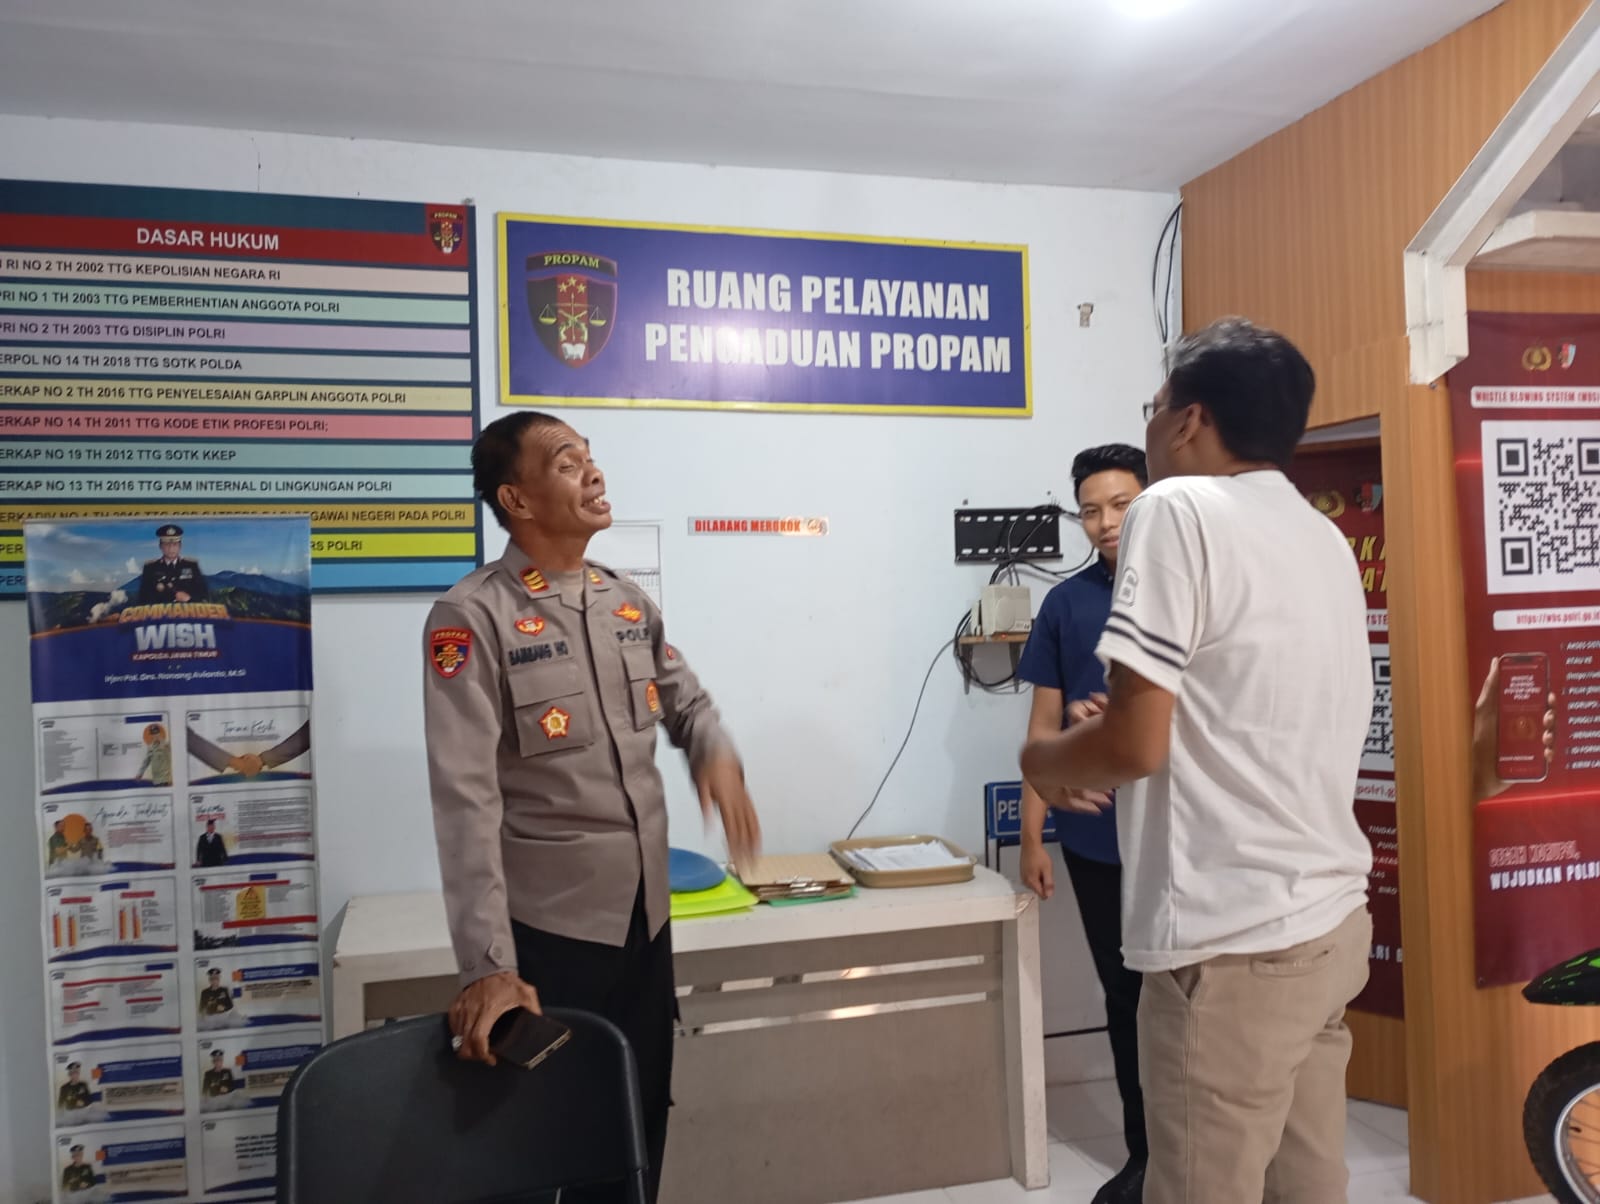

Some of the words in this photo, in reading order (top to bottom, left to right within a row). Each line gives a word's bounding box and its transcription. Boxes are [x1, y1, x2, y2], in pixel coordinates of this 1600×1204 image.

[137, 228, 204, 247] DASAR
[210, 232, 279, 250] HUKUM
[7, 259, 19, 270] RI
[23, 260, 42, 271] NO
[45, 260, 52, 271] 2
[56, 261, 72, 272] TH
[76, 261, 104, 273] 2002
[107, 262, 132, 274] TTG
[136, 264, 210, 279] KEPOLISIAN
[214, 267, 266, 281] NEGARA
[269, 270, 281, 281] RI
[544, 254, 600, 268] PROPAM
[0, 290, 15, 302] RI
[19, 291, 38, 302] NO
[42, 291, 48, 303] 1
[52, 292, 69, 303] TH
[73, 293, 101, 305] 2003
[104, 294, 129, 306] TTG
[132, 295, 239, 309] PEMBERHENTIAN
[241, 299, 301, 312] ANGGOTA
[304, 302, 340, 313] POLRI
[666, 268, 792, 313] RUANG
[801, 275, 990, 321] PELAYANAN
[0, 322, 16, 333] RI
[20, 323, 38, 334] NO
[42, 323, 49, 334] 2
[52, 323, 69, 335] TH
[73, 324, 101, 336] 2003
[104, 325, 129, 336] TTG
[133, 326, 185, 338] DISIPLIN
[188, 328, 226, 340] POLRI
[645, 323, 861, 369] PENGADUAN
[870, 332, 1012, 373] PROPAM
[43, 354, 62, 366] NO
[66, 355, 80, 366] 14
[82, 356, 100, 367] TH
[103, 356, 131, 368] 2018
[135, 357, 159, 369] TTG
[163, 357, 197, 369] SOTK
[200, 359, 243, 370] POLDA
[44, 385, 62, 397] NO
[66, 386, 74, 397] 2
[78, 386, 94, 398] TH
[97, 386, 125, 398] 2016
[129, 387, 153, 399] TTG
[157, 388, 252, 401] PENYELESAIAN
[255, 390, 308, 402] GARPLIN
[310, 391, 369, 403] ANGGOTA
[372, 392, 407, 404] POLRI
[44, 416, 64, 428] NO
[67, 417, 81, 428] 14
[86, 417, 102, 428] TH
[105, 417, 132, 429] 2011
[136, 417, 161, 429] TTG
[164, 418, 200, 430] KODE
[203, 418, 230, 430] ETIK
[234, 418, 286, 430] PROFESI
[289, 420, 329, 432] POLRI;
[45, 449, 64, 460] NO
[68, 449, 82, 460] 19
[86, 450, 102, 461] TH
[105, 450, 134, 461] 2012
[138, 450, 162, 461] TTG
[166, 450, 200, 461] SOTK
[203, 450, 237, 461] KKEP
[46, 480, 65, 491] NO
[70, 481, 83, 492] 13
[86, 480, 103, 492] TH
[106, 481, 134, 492] 2016
[138, 481, 163, 492] TTG
[166, 481, 193, 491] PAM
[196, 480, 257, 492] INTERNAL
[260, 481, 272, 492] DI
[275, 480, 354, 492] LINGKUNGAN
[357, 481, 392, 492] POLRI
[352, 510, 395, 521] NEGERI
[398, 510, 429, 521] PADA
[432, 510, 466, 521] POLRI
[695, 519, 748, 532] DILARANG
[750, 519, 801, 532] MEROKOK
[327, 541, 362, 551] POLRI
[119, 602, 230, 623] COMMANDER
[135, 622, 217, 652] WISH
[1490, 865, 1562, 891] WUJUDKAN
